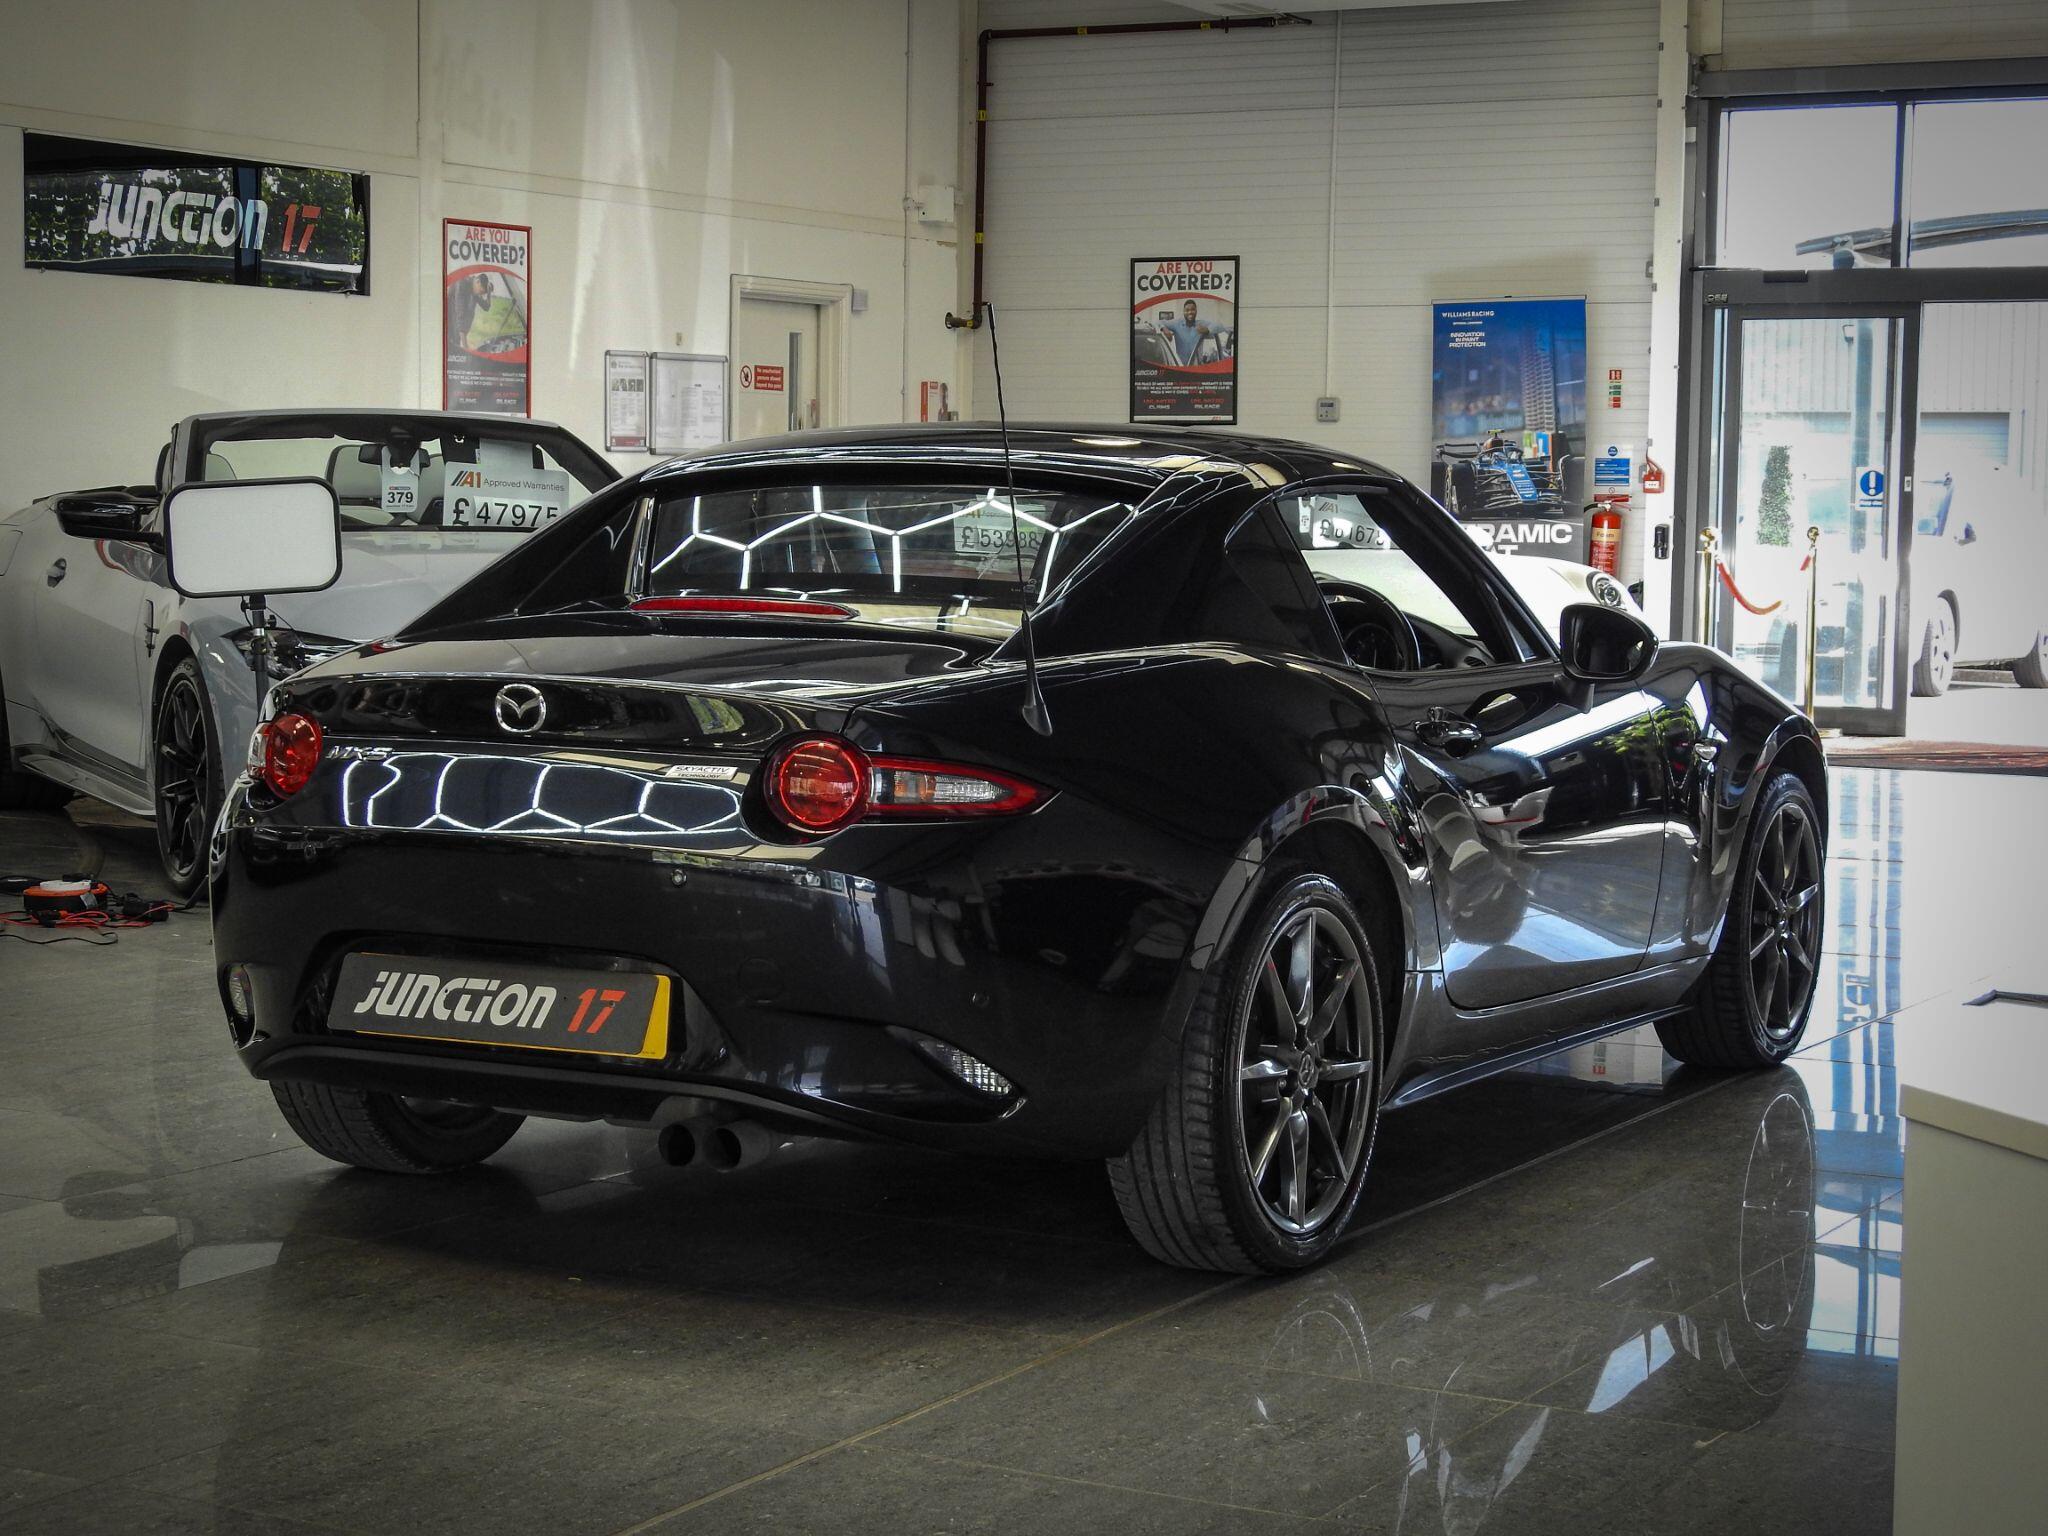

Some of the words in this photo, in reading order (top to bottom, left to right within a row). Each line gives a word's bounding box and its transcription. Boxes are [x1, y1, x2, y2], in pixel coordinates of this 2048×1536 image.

[87, 183, 268, 249] JUNCTION
[282, 203, 321, 253] 17
[465, 226, 486, 241] ARE
[489, 229, 510, 244] YOU
[448, 239, 526, 266] COVERED?
[1156, 262, 1182, 274] ARE
[1186, 261, 1213, 273] YOU
[1137, 272, 1233, 291] COVERED?
[484, 477, 521, 489] Approved
[522, 480, 566, 492] Warranties
[387, 491, 414, 504] 379
[354, 970, 558, 1029] JUNCTION
[567, 988, 627, 1034] 17
